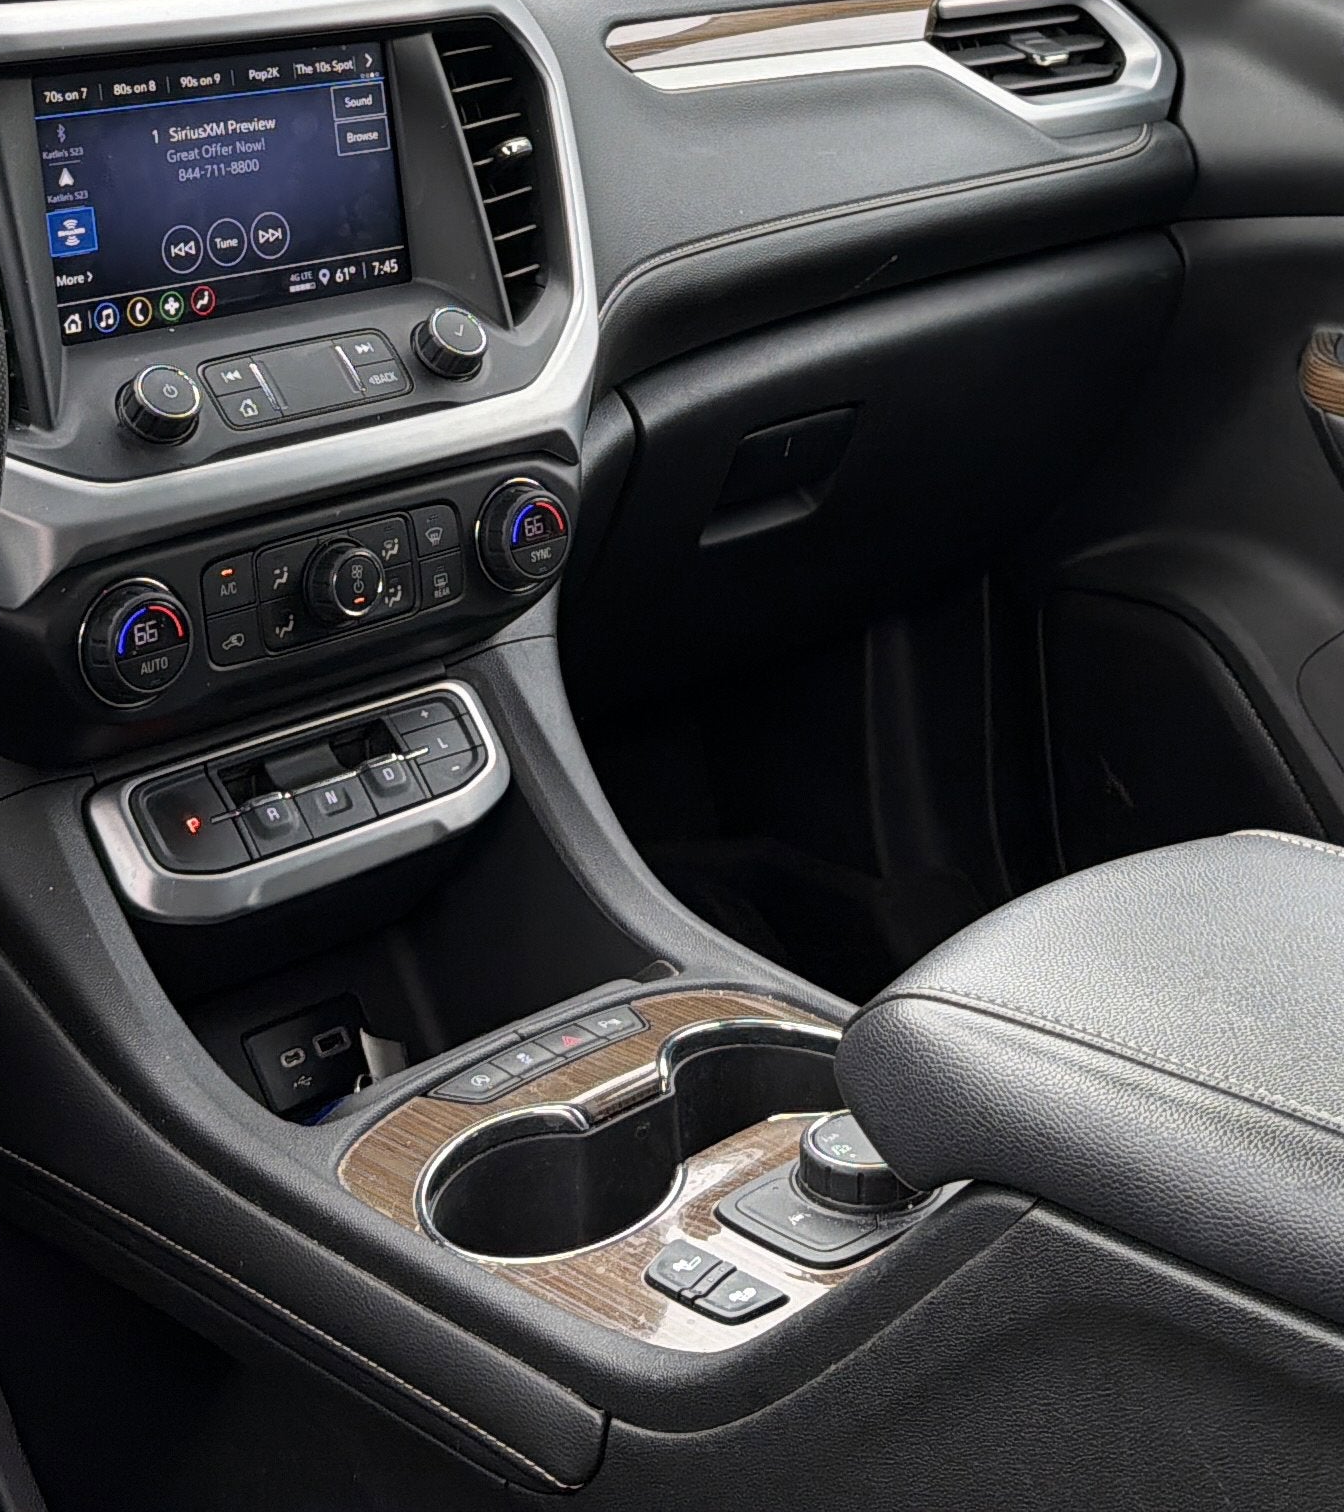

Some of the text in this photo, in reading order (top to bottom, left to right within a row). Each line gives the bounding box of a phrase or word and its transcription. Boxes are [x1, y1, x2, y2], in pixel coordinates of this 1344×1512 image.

[248, 67, 280, 82] Pop2K
[295, 59, 354, 76] The 10s Spot
[113, 79, 157, 96] 80s on 8
[180, 72, 221, 89] 90s on 9
[43, 87, 88, 104] 70s on 7
[344, 94, 373, 109] Sound
[151, 117, 276, 144] 1 SiriusXM Preview
[346, 129, 379, 144] Browse
[166, 137, 266, 164] Great Offer Now!
[178, 158, 260, 182] 844-711-8800
[215, 237, 238, 249] Tune
[335, 266, 357, 283] 61°
[371, 259, 399, 276] 7:45
[56, 273, 85, 288] More
[373, 370, 398, 386] BACK
[523, 515, 545, 537] 66
[530, 546, 553, 564] SYNC
[220, 581, 238, 597] A/C
[433, 586, 451, 598] REAR
[134, 621, 158, 646] 66
[140, 656, 169, 676] AUTO
[436, 737, 449, 750] L
[382, 767, 395, 781] D
[324, 789, 338, 805] N
[266, 807, 280, 821] R
[186, 816, 201, 834] P
